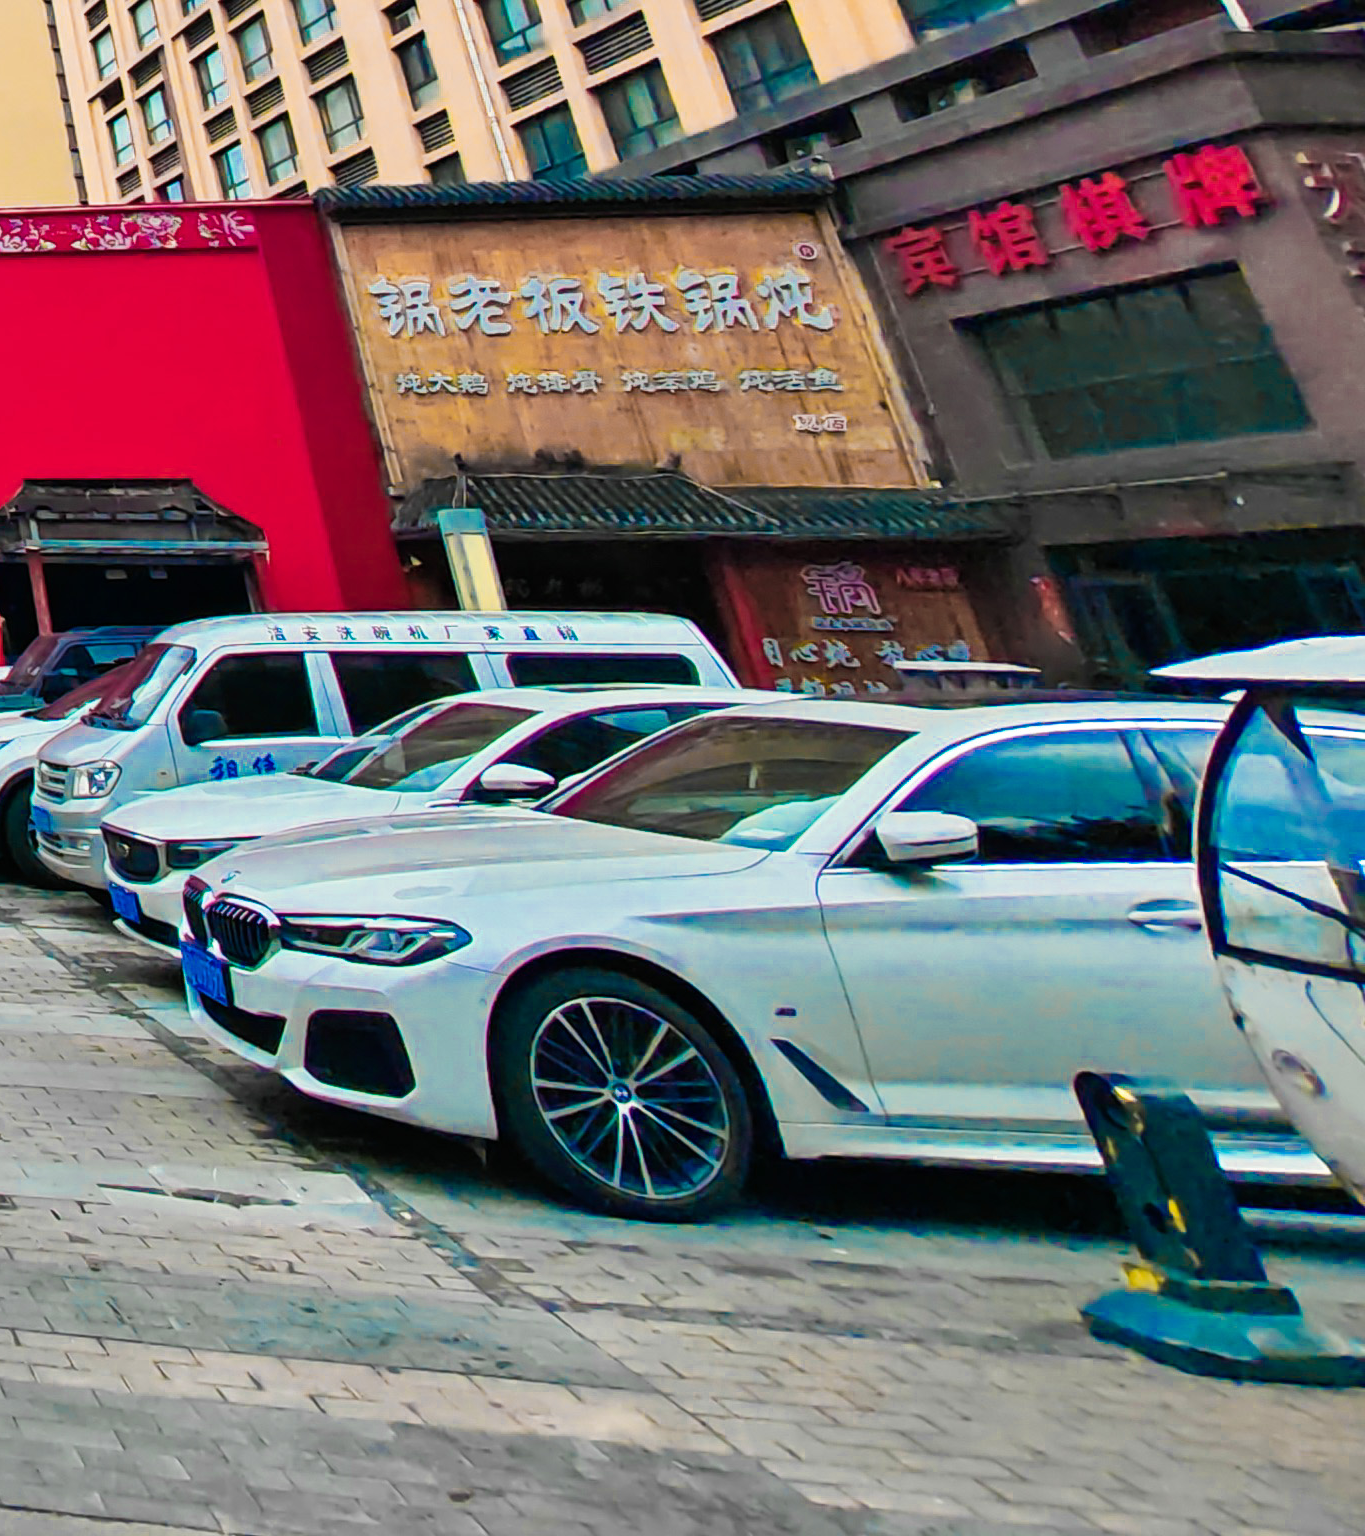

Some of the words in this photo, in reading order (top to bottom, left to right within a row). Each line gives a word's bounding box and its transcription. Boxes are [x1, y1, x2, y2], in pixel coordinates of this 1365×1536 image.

[368, 268, 835, 337] 锅老板铁锅炖
[395, 372, 488, 395] 炖大鹅
